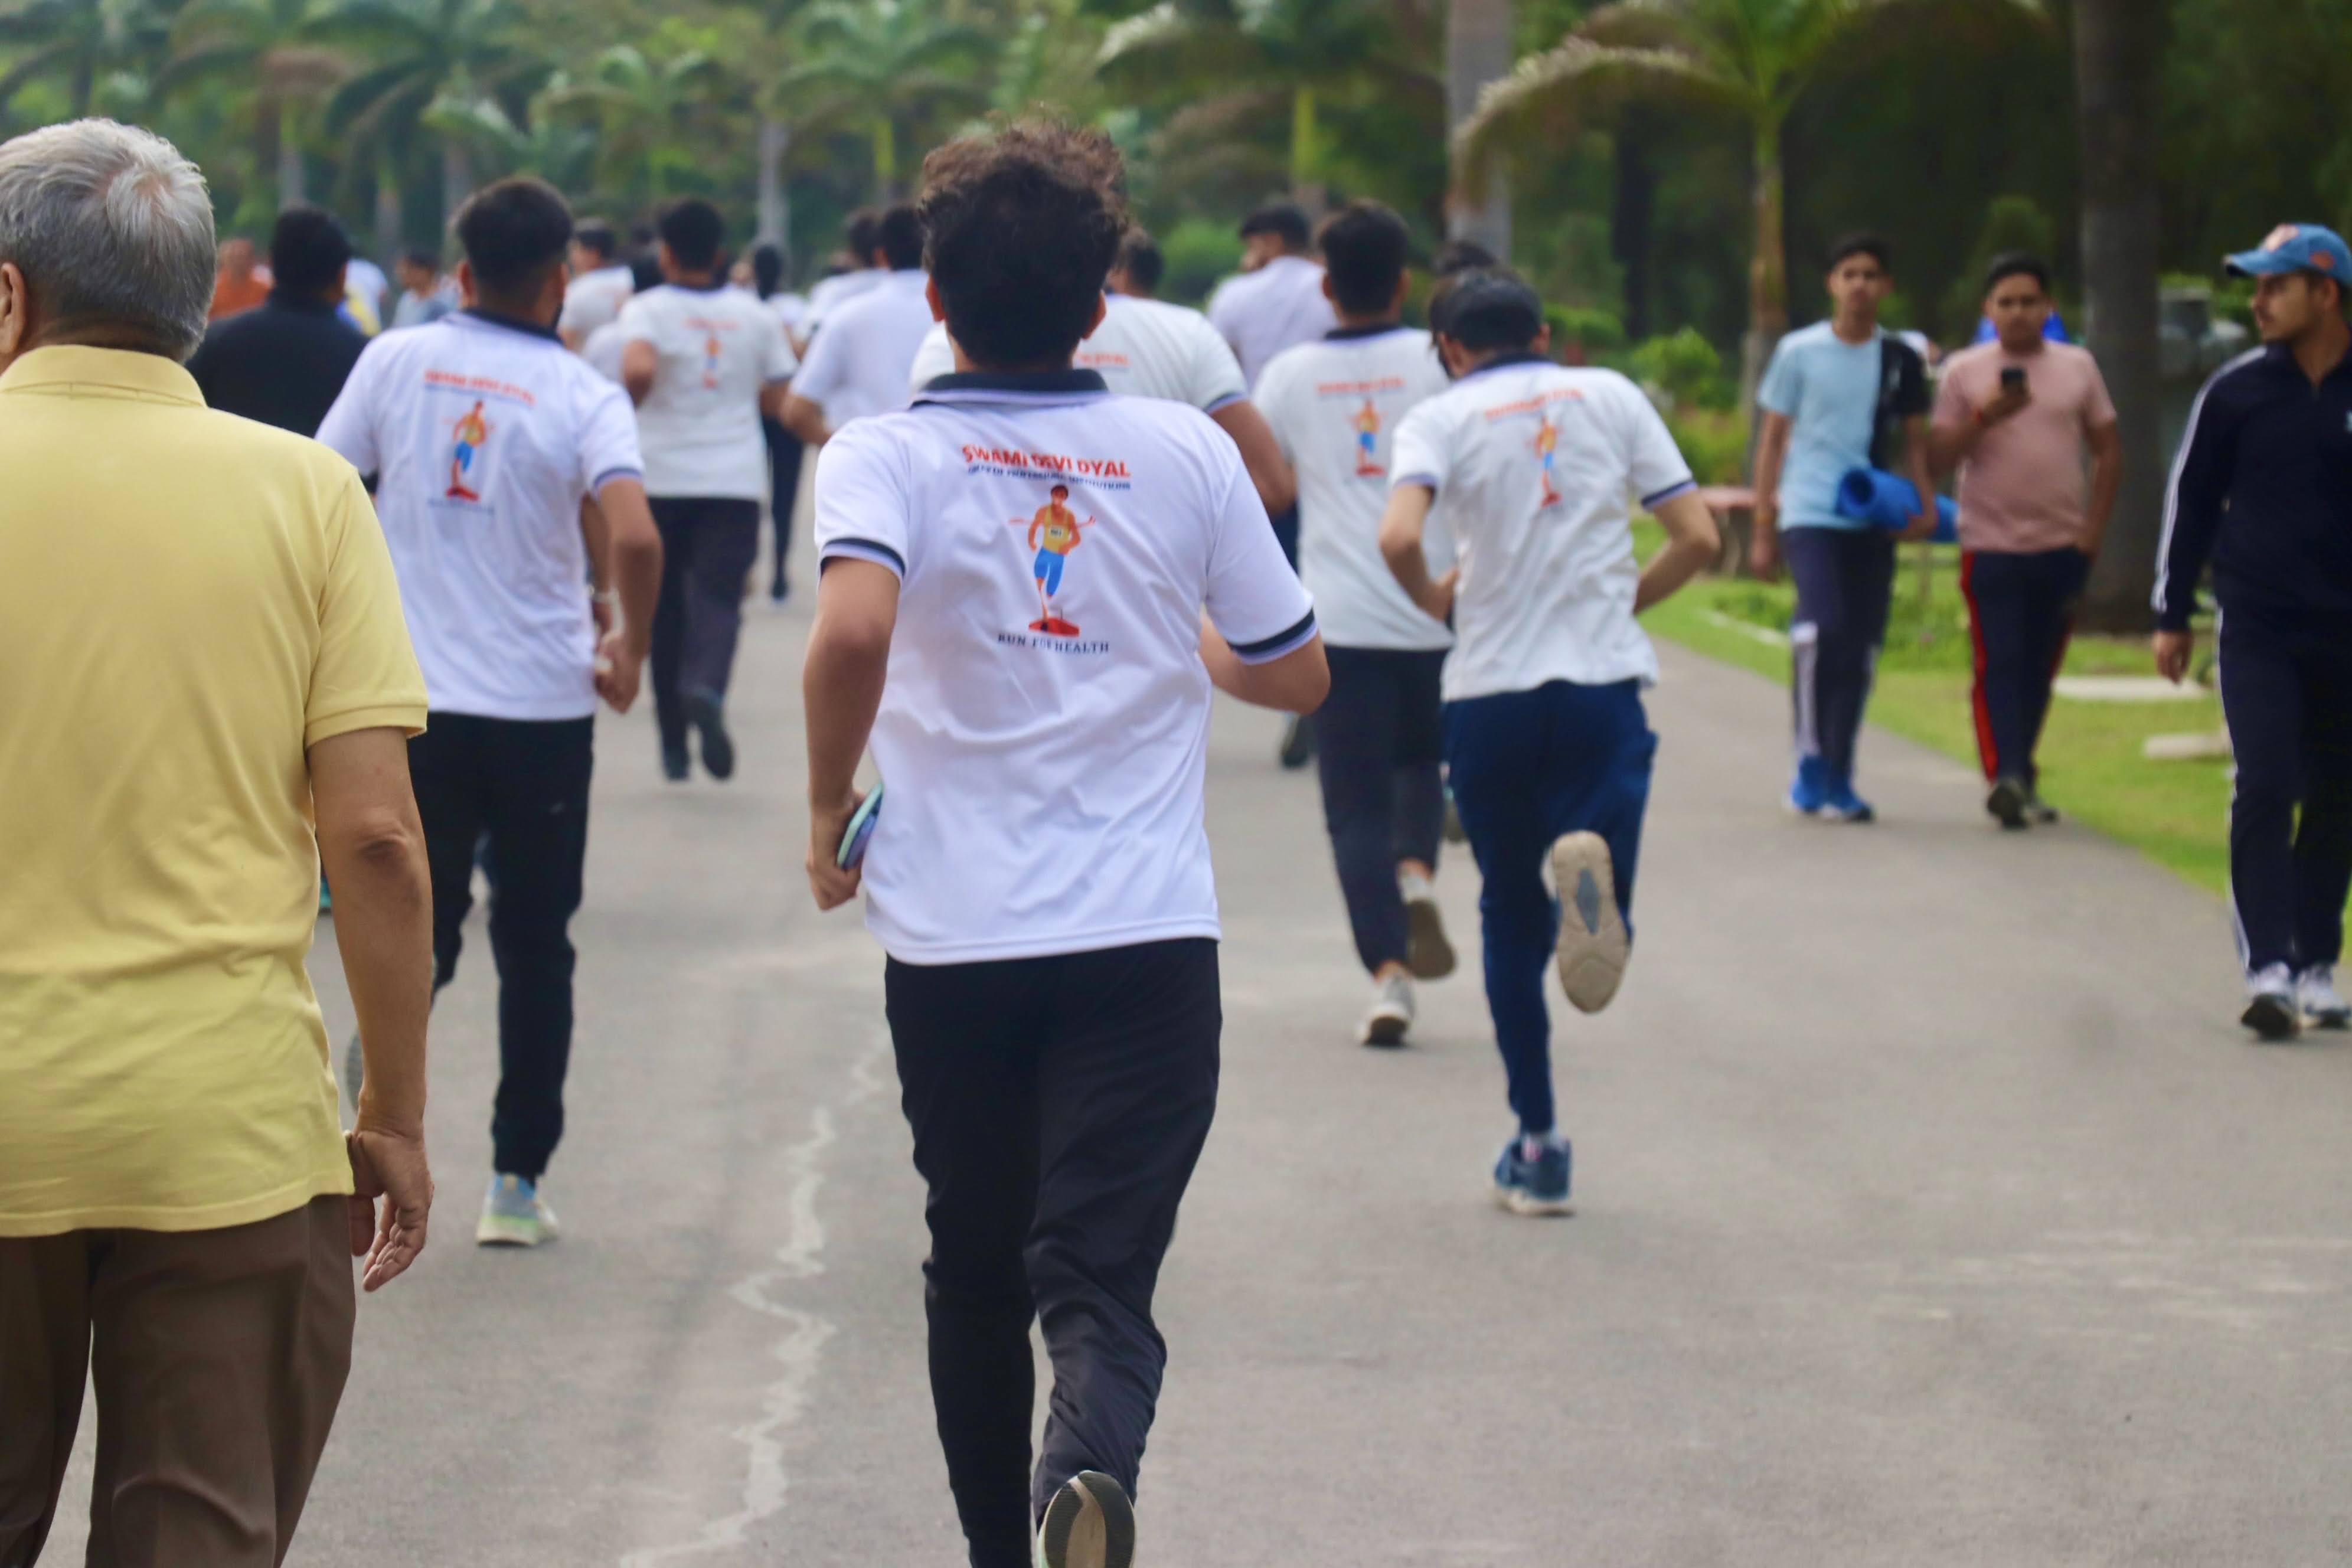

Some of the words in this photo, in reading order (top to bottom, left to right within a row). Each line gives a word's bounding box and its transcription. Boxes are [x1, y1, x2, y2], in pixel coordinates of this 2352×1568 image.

[962, 444, 1028, 468] SWAMI
[1077, 458, 1131, 479] DYAL
[998, 633, 1026, 646] RUN
[1055, 641, 1109, 653] HEALTH
